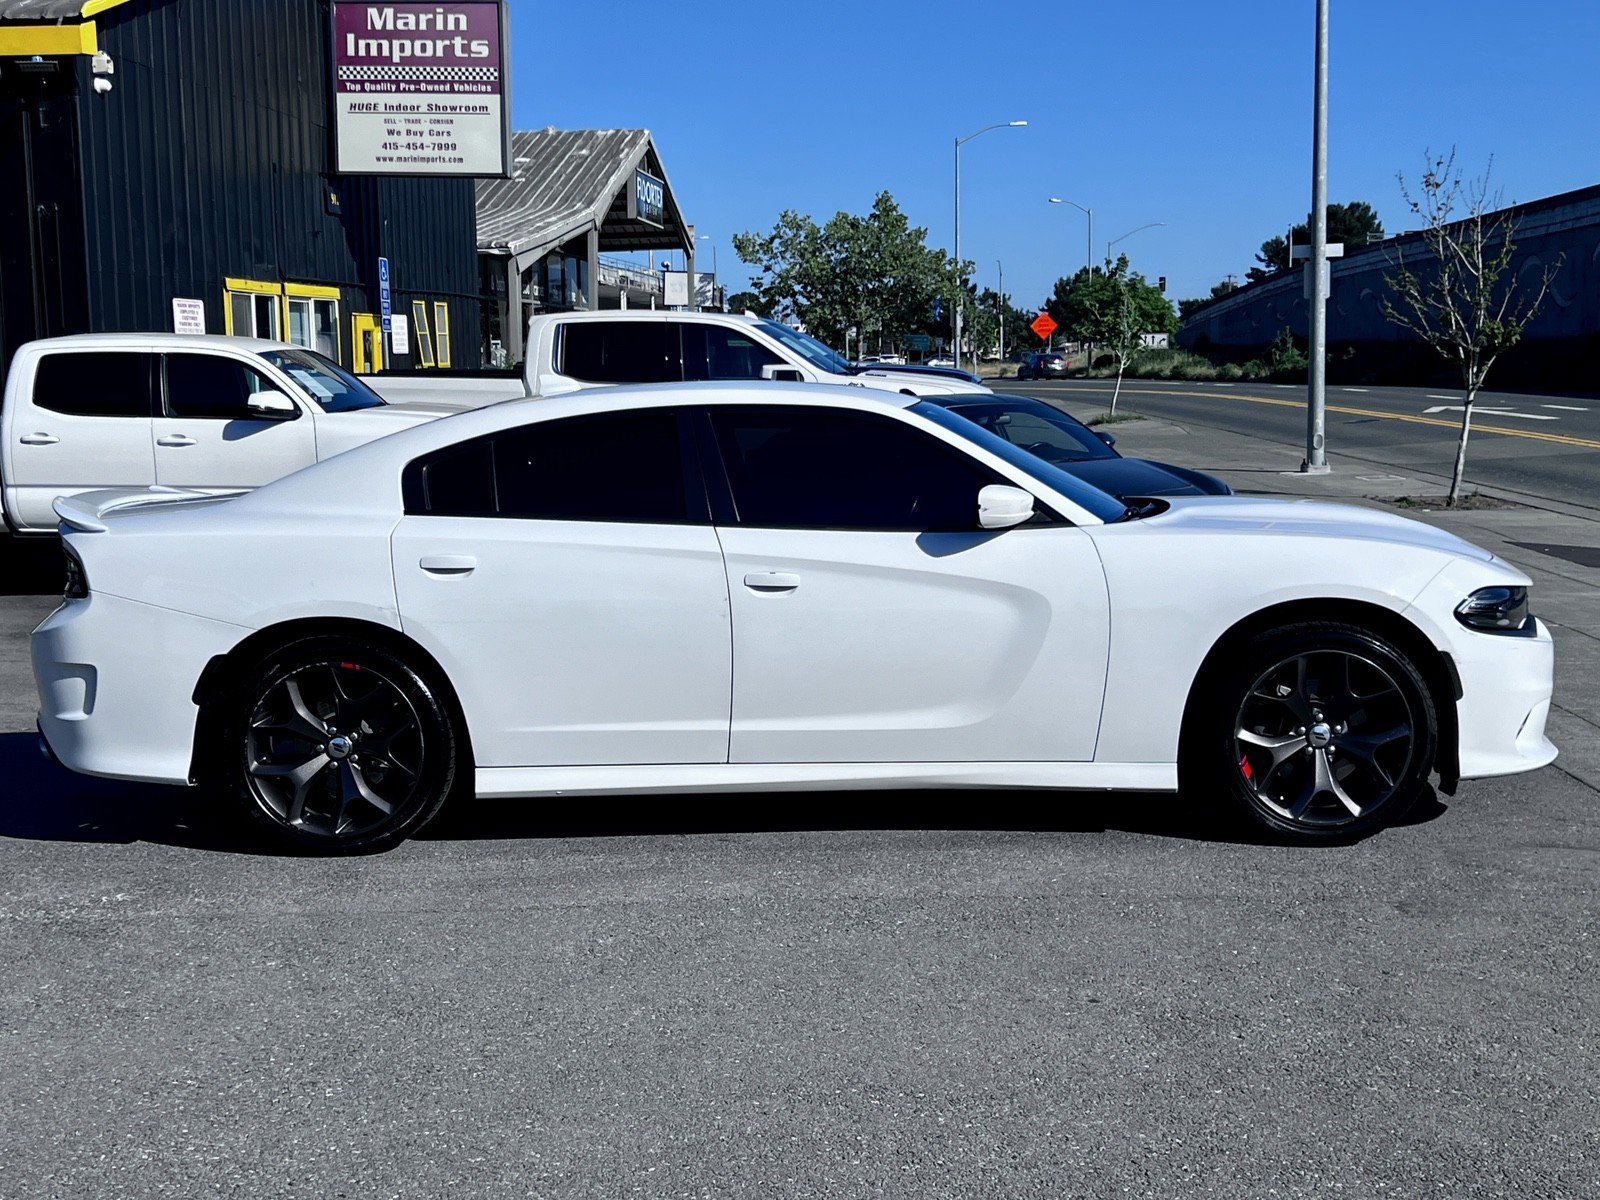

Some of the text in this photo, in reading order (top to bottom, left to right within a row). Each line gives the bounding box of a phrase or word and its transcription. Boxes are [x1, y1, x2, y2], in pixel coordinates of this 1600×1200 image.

[367, 8, 467, 31] Marin
[346, 33, 489, 63] Imports
[345, 82, 492, 92] Top Quality Pre-Owned Vehicles
[349, 102, 489, 112] HUGE Indoor Showroom
[387, 128, 452, 138] We Buy Cars
[381, 142, 457, 152] 415-454-7999
[375, 154, 464, 164] www.marinimports.com
